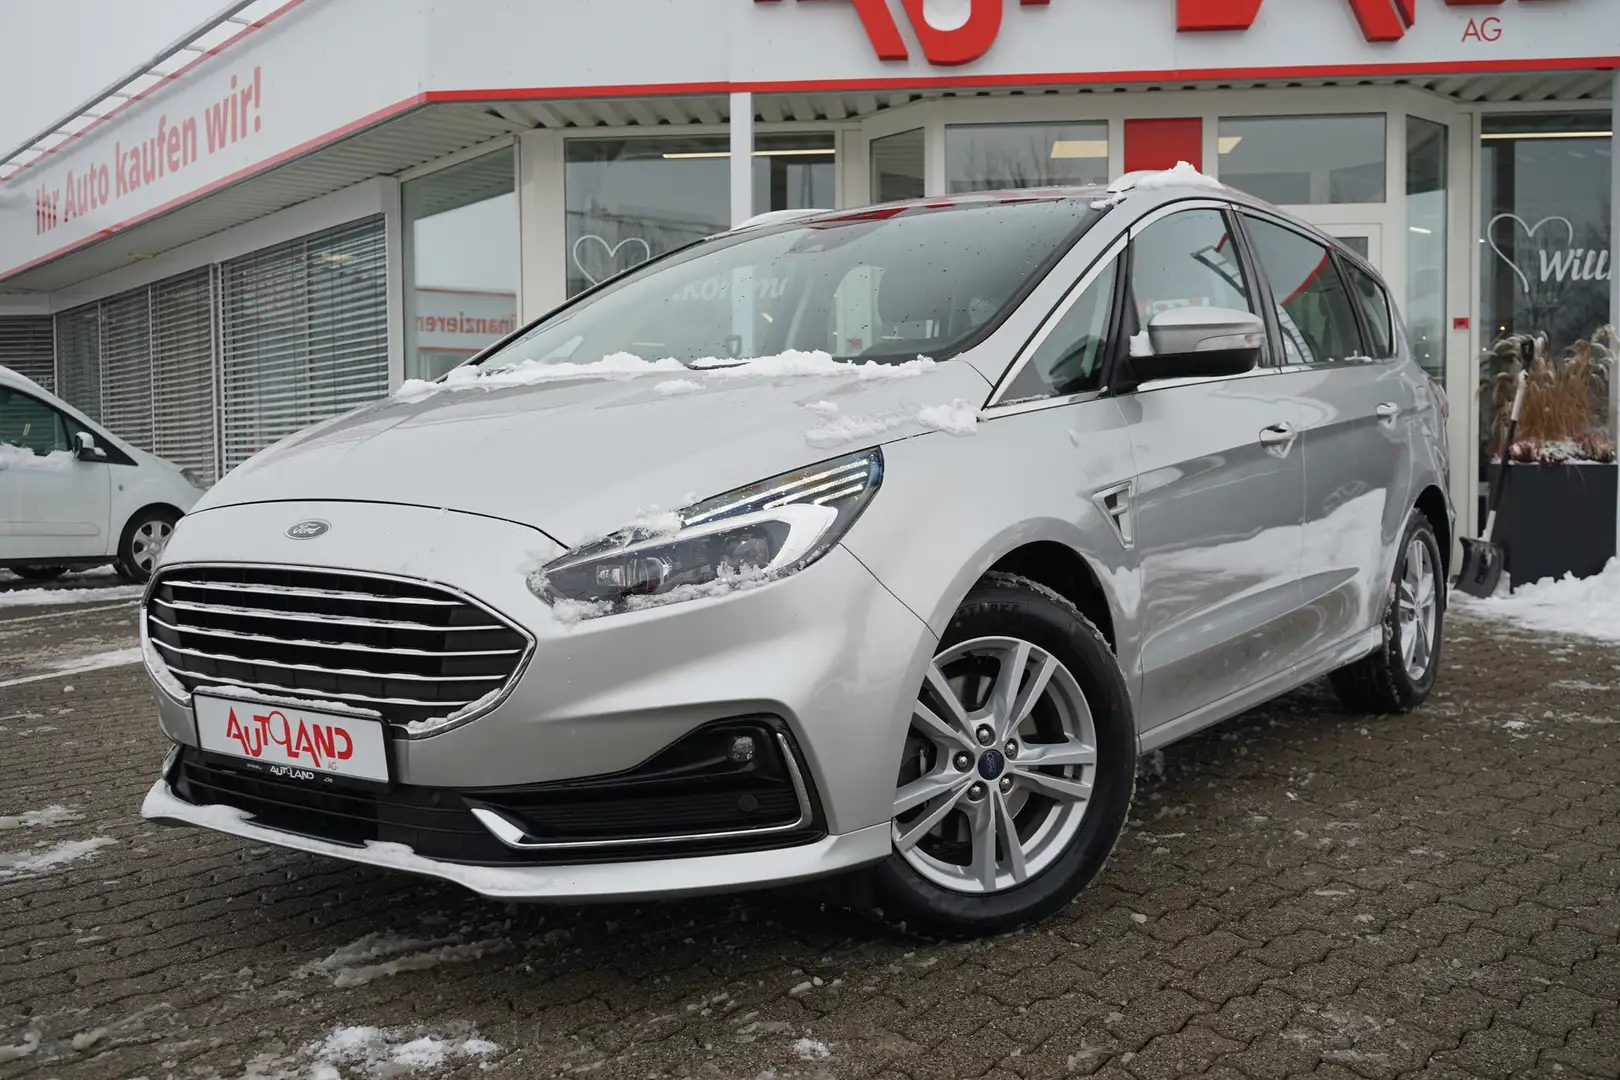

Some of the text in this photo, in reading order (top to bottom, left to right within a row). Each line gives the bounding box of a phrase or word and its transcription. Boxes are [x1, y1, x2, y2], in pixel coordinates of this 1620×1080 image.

[1461, 17, 1502, 42] AG
[36, 66, 262, 236] Ihr Auto kaufen wir!
[1539, 248, 1611, 282] Will
[226, 706, 354, 768] AUTOLAND
[270, 765, 314, 780] AUTOLAND
[327, 761, 338, 771] AG
